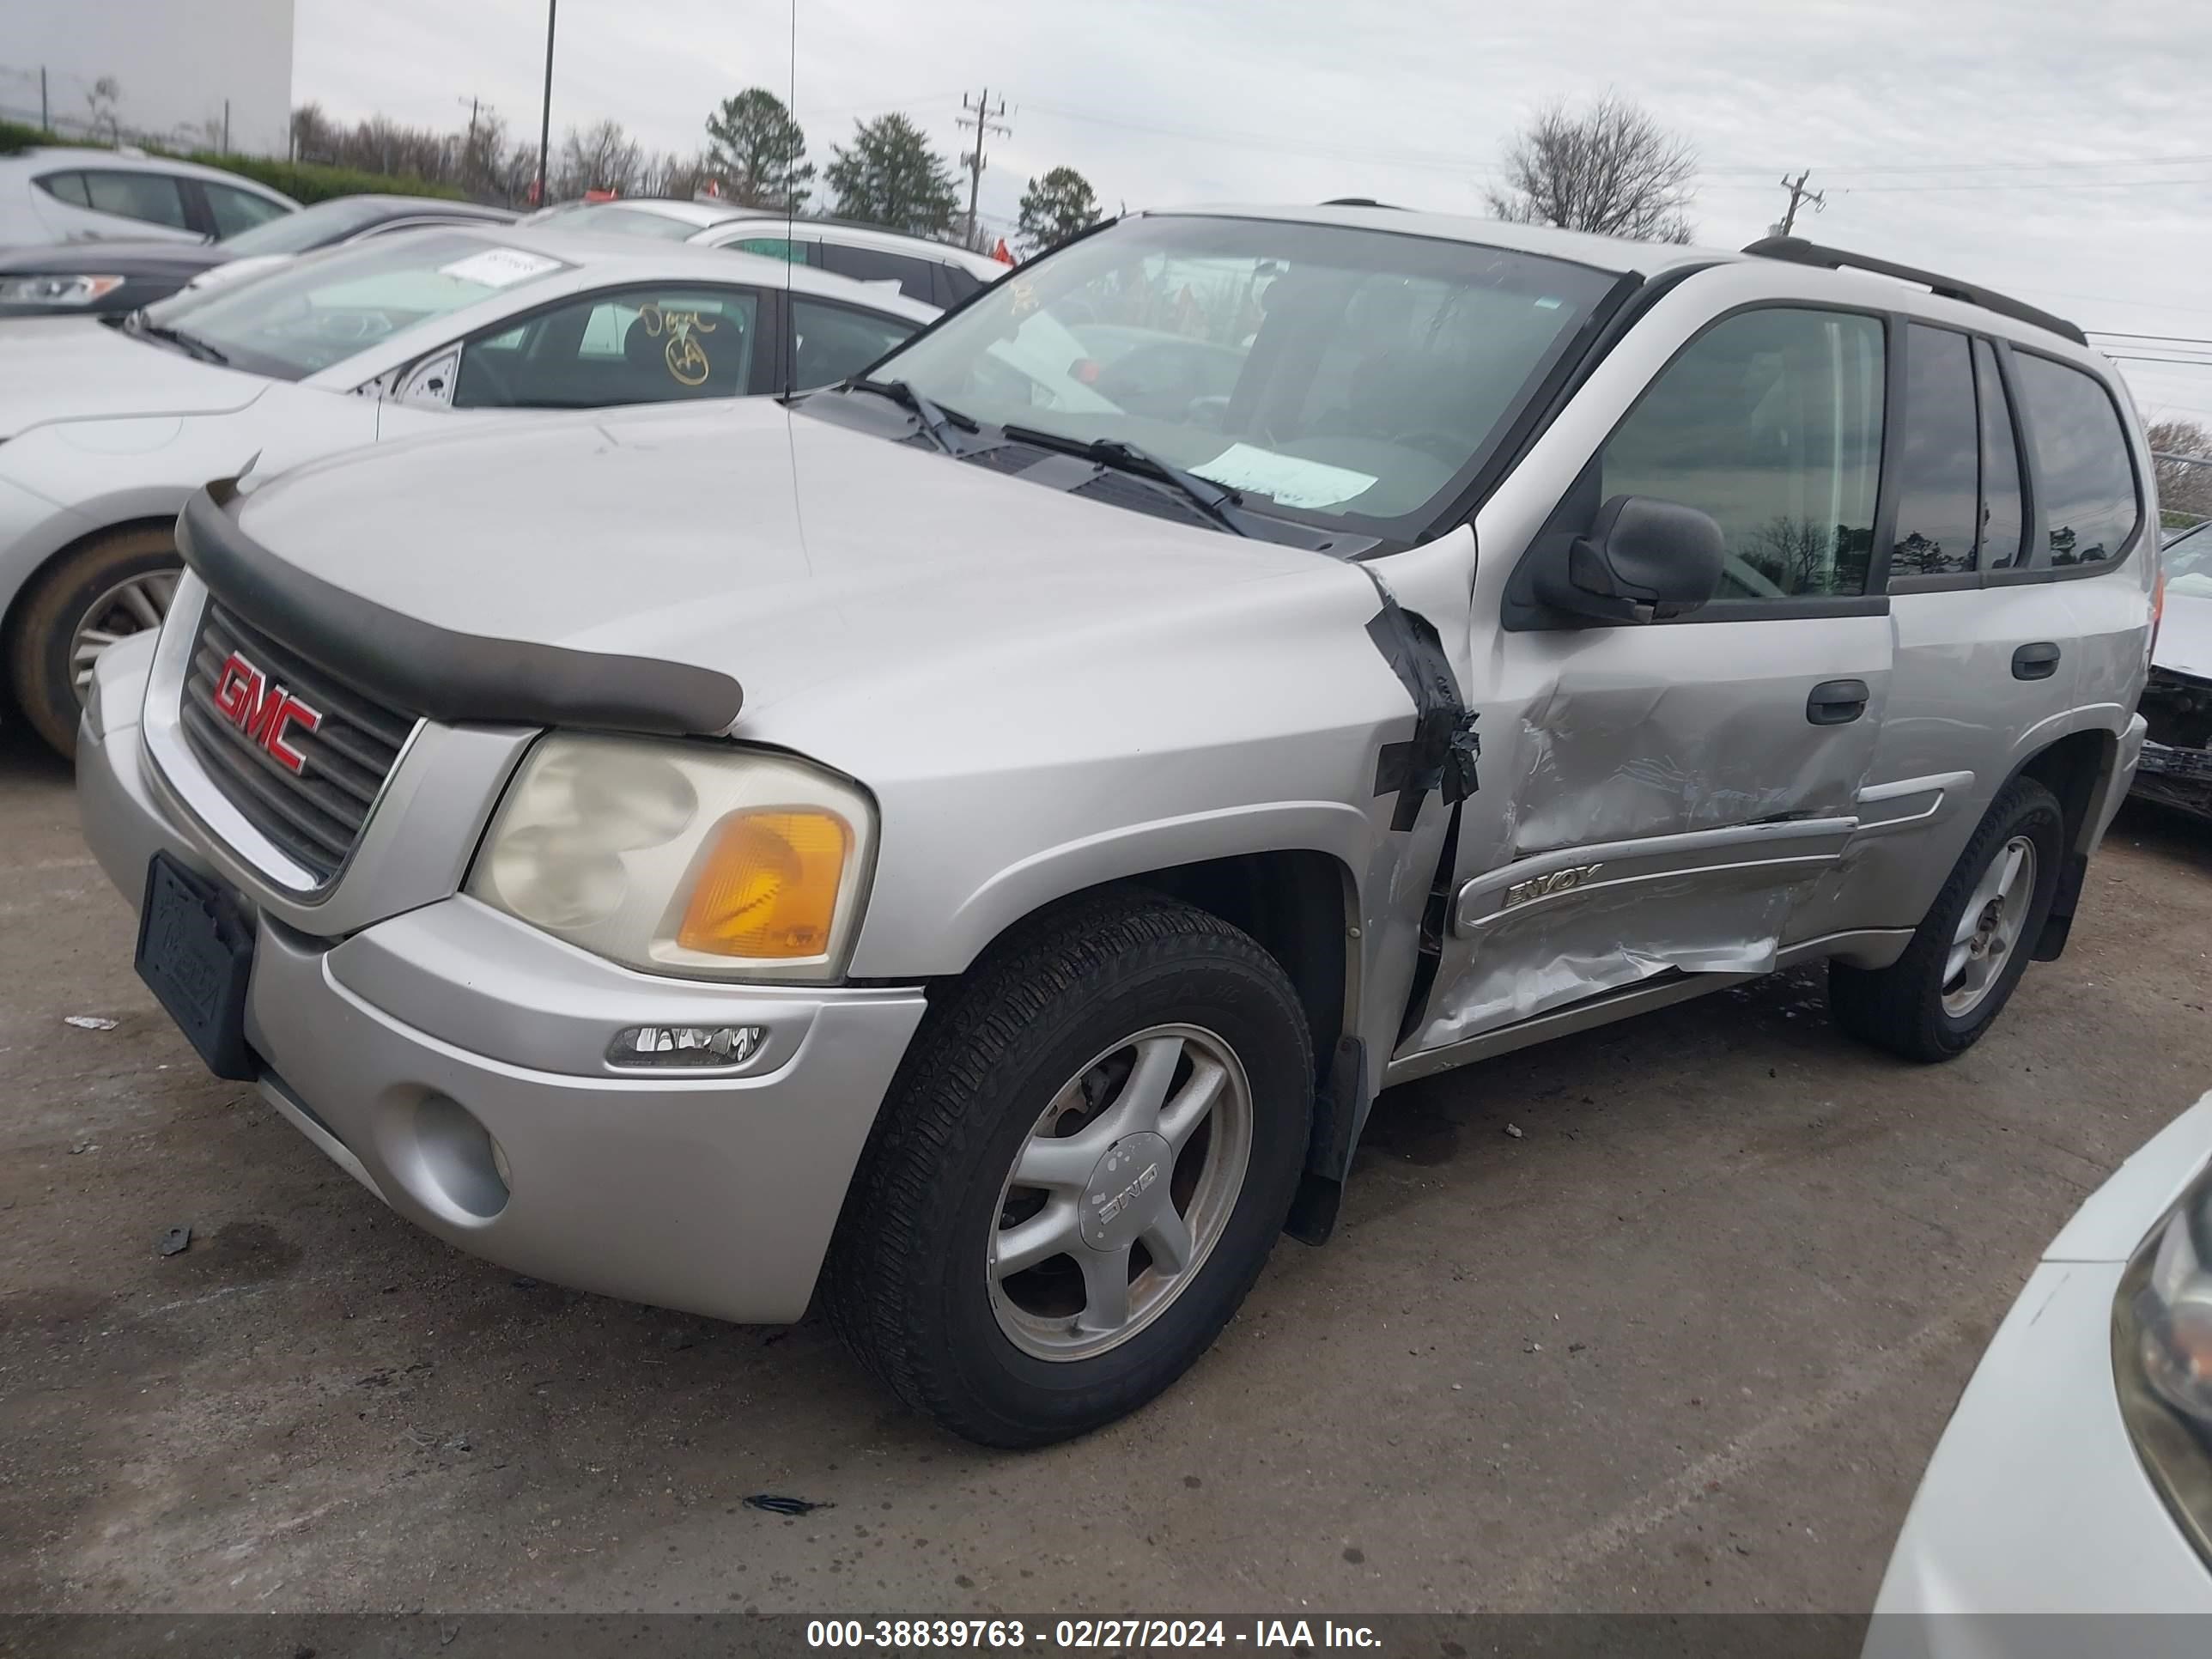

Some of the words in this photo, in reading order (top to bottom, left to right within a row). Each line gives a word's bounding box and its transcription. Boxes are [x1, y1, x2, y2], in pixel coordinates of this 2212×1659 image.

[214, 650, 323, 776] GMC
[1502, 863, 1604, 908] ENVOY
[1098, 1162, 1159, 1225] GMC
